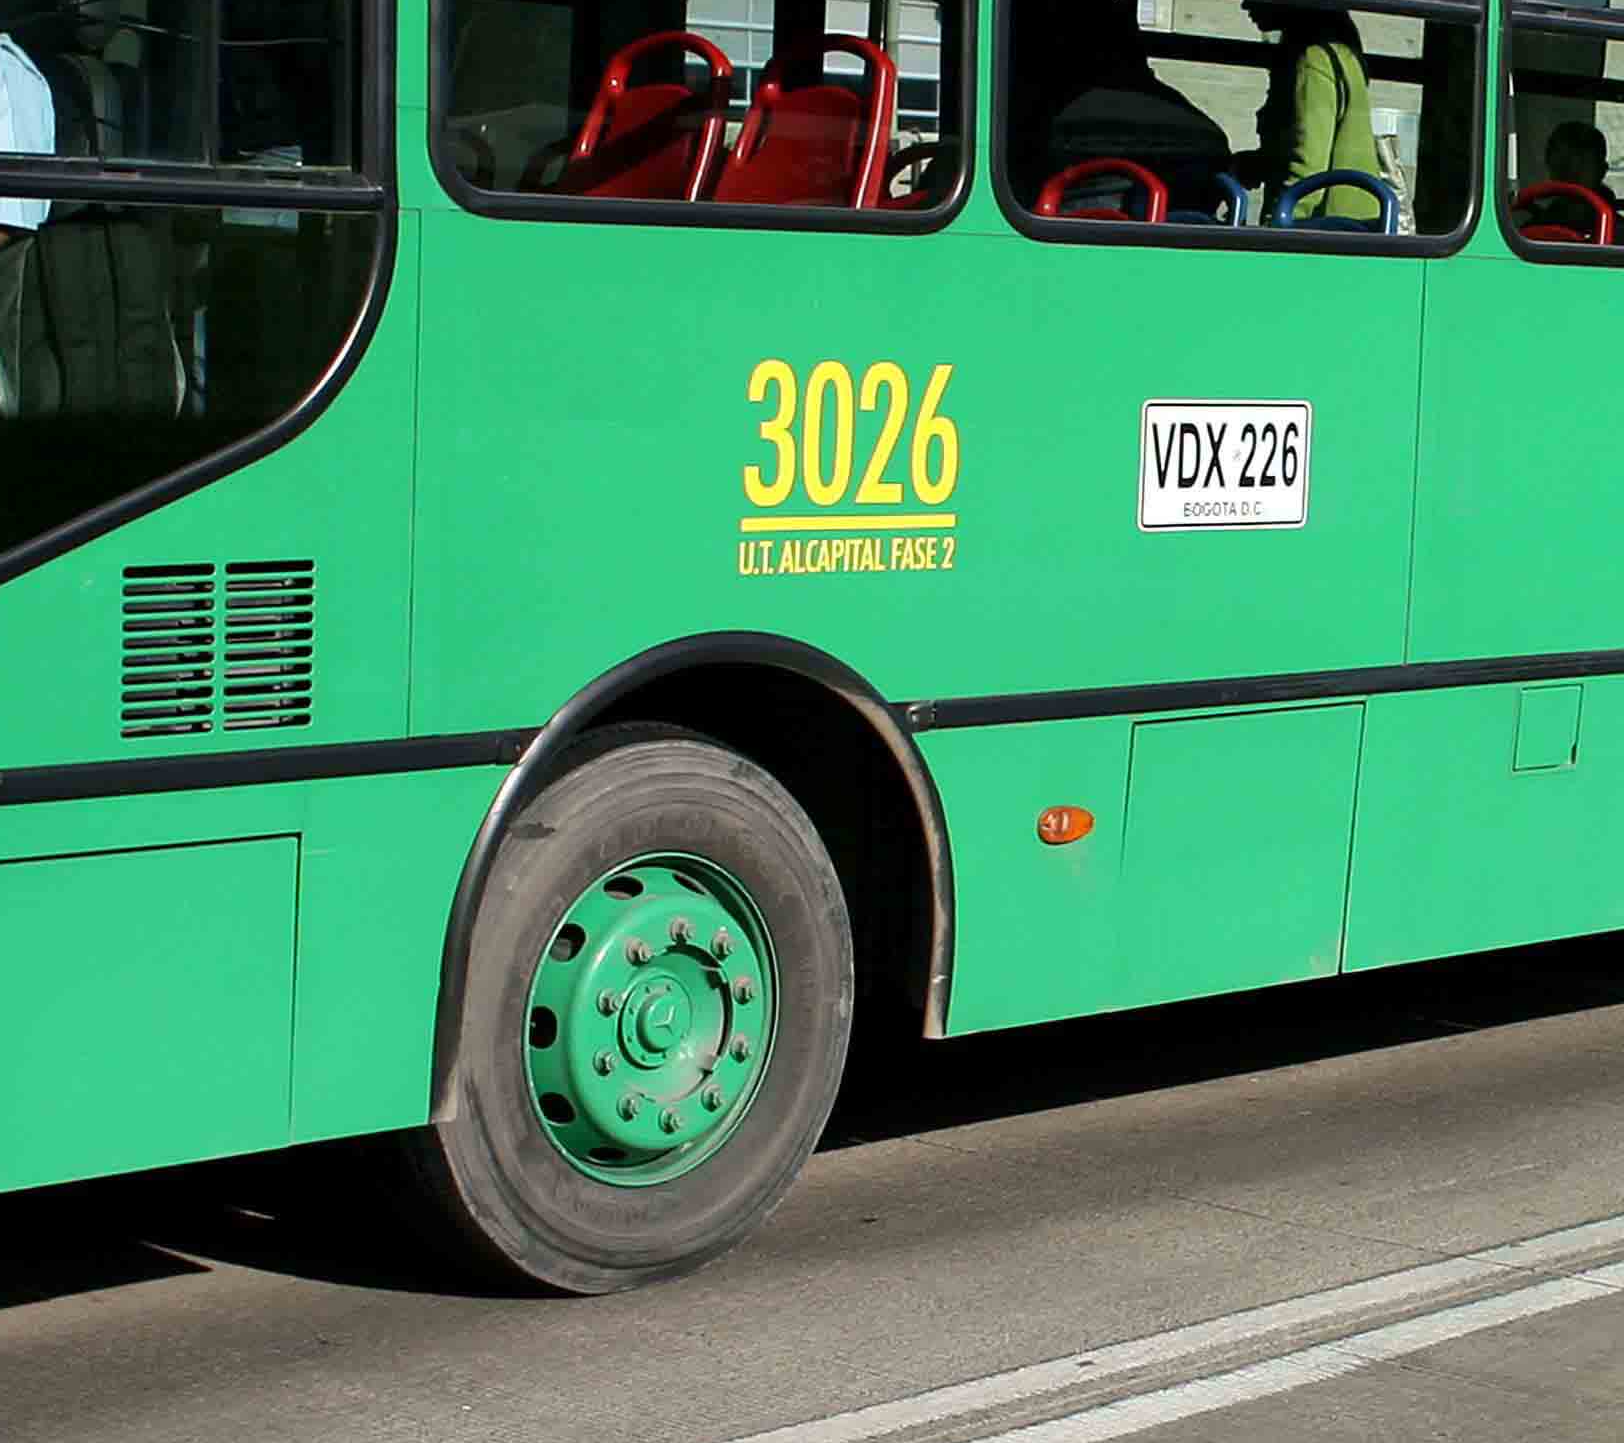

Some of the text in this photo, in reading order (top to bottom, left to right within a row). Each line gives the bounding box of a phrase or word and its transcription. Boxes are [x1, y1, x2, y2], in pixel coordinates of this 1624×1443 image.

[742, 358, 961, 508] 3026
[1151, 421, 1300, 490] VDX 226
[737, 535, 956, 576] U.T. ALCAPITAL FASE 2
